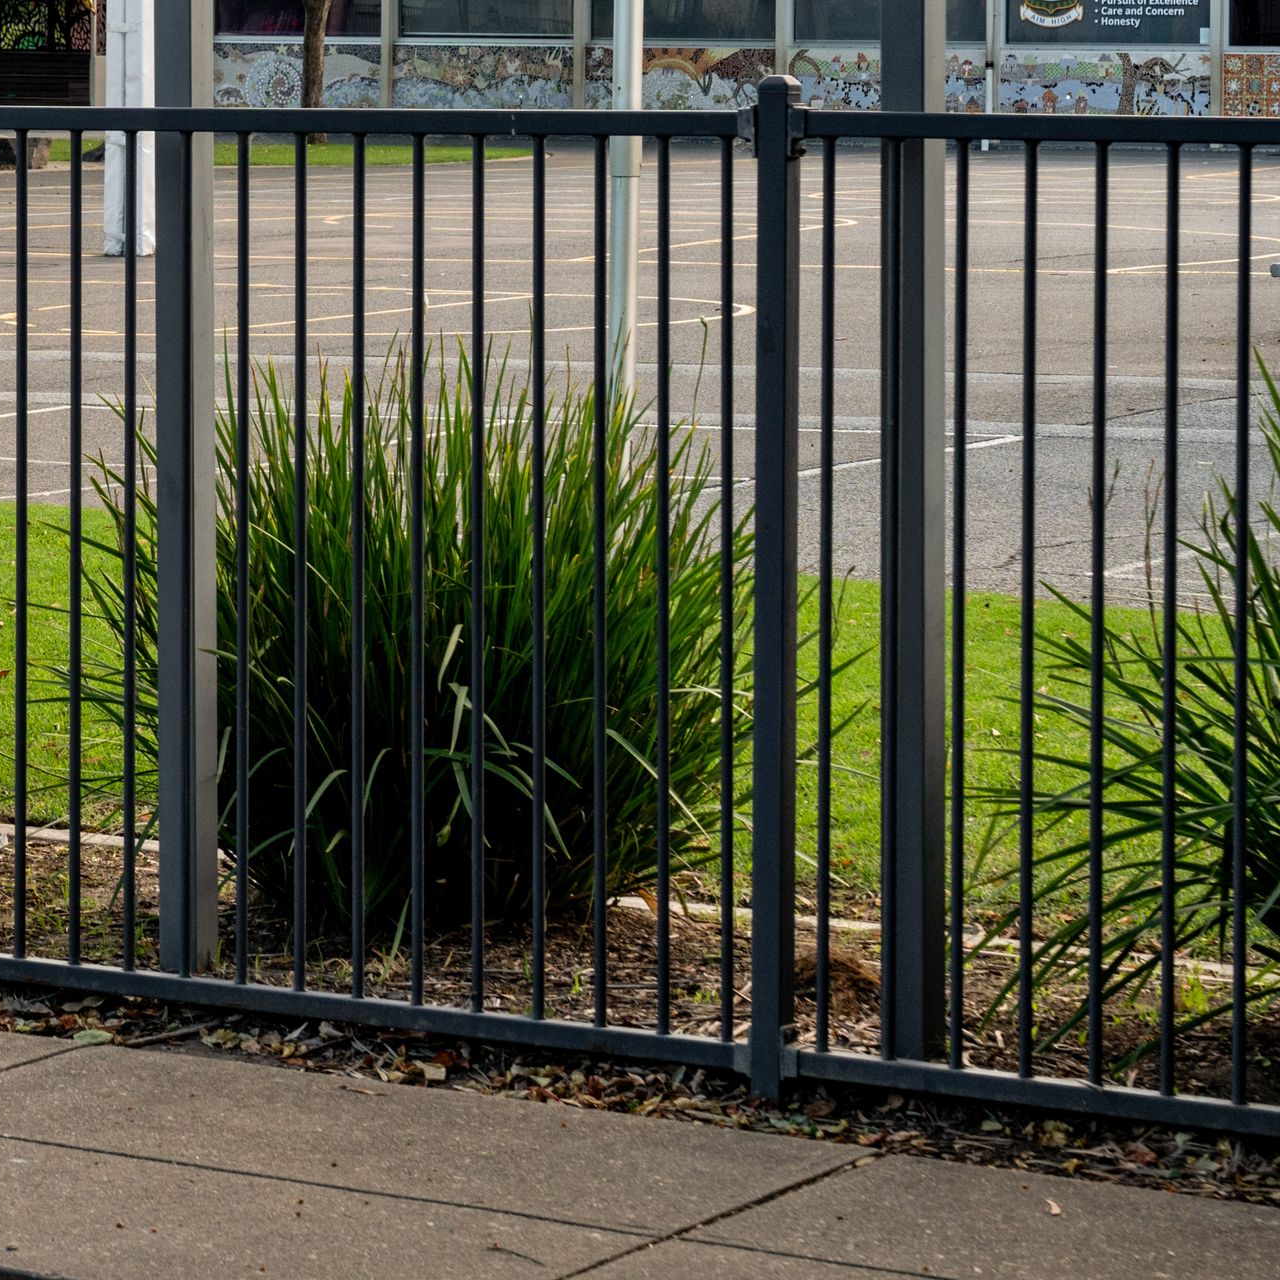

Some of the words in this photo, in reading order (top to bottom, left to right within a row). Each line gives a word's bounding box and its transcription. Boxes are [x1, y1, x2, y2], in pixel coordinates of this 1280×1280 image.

[1101, 7, 1123, 15] Care
[1125, 6, 1143, 15] and
[1145, 7, 1184, 15] Concern
[1031, 15, 1045, 24] AIM
[1051, 15, 1072, 24] HIGH
[1101, 17, 1140, 28] Honesty
